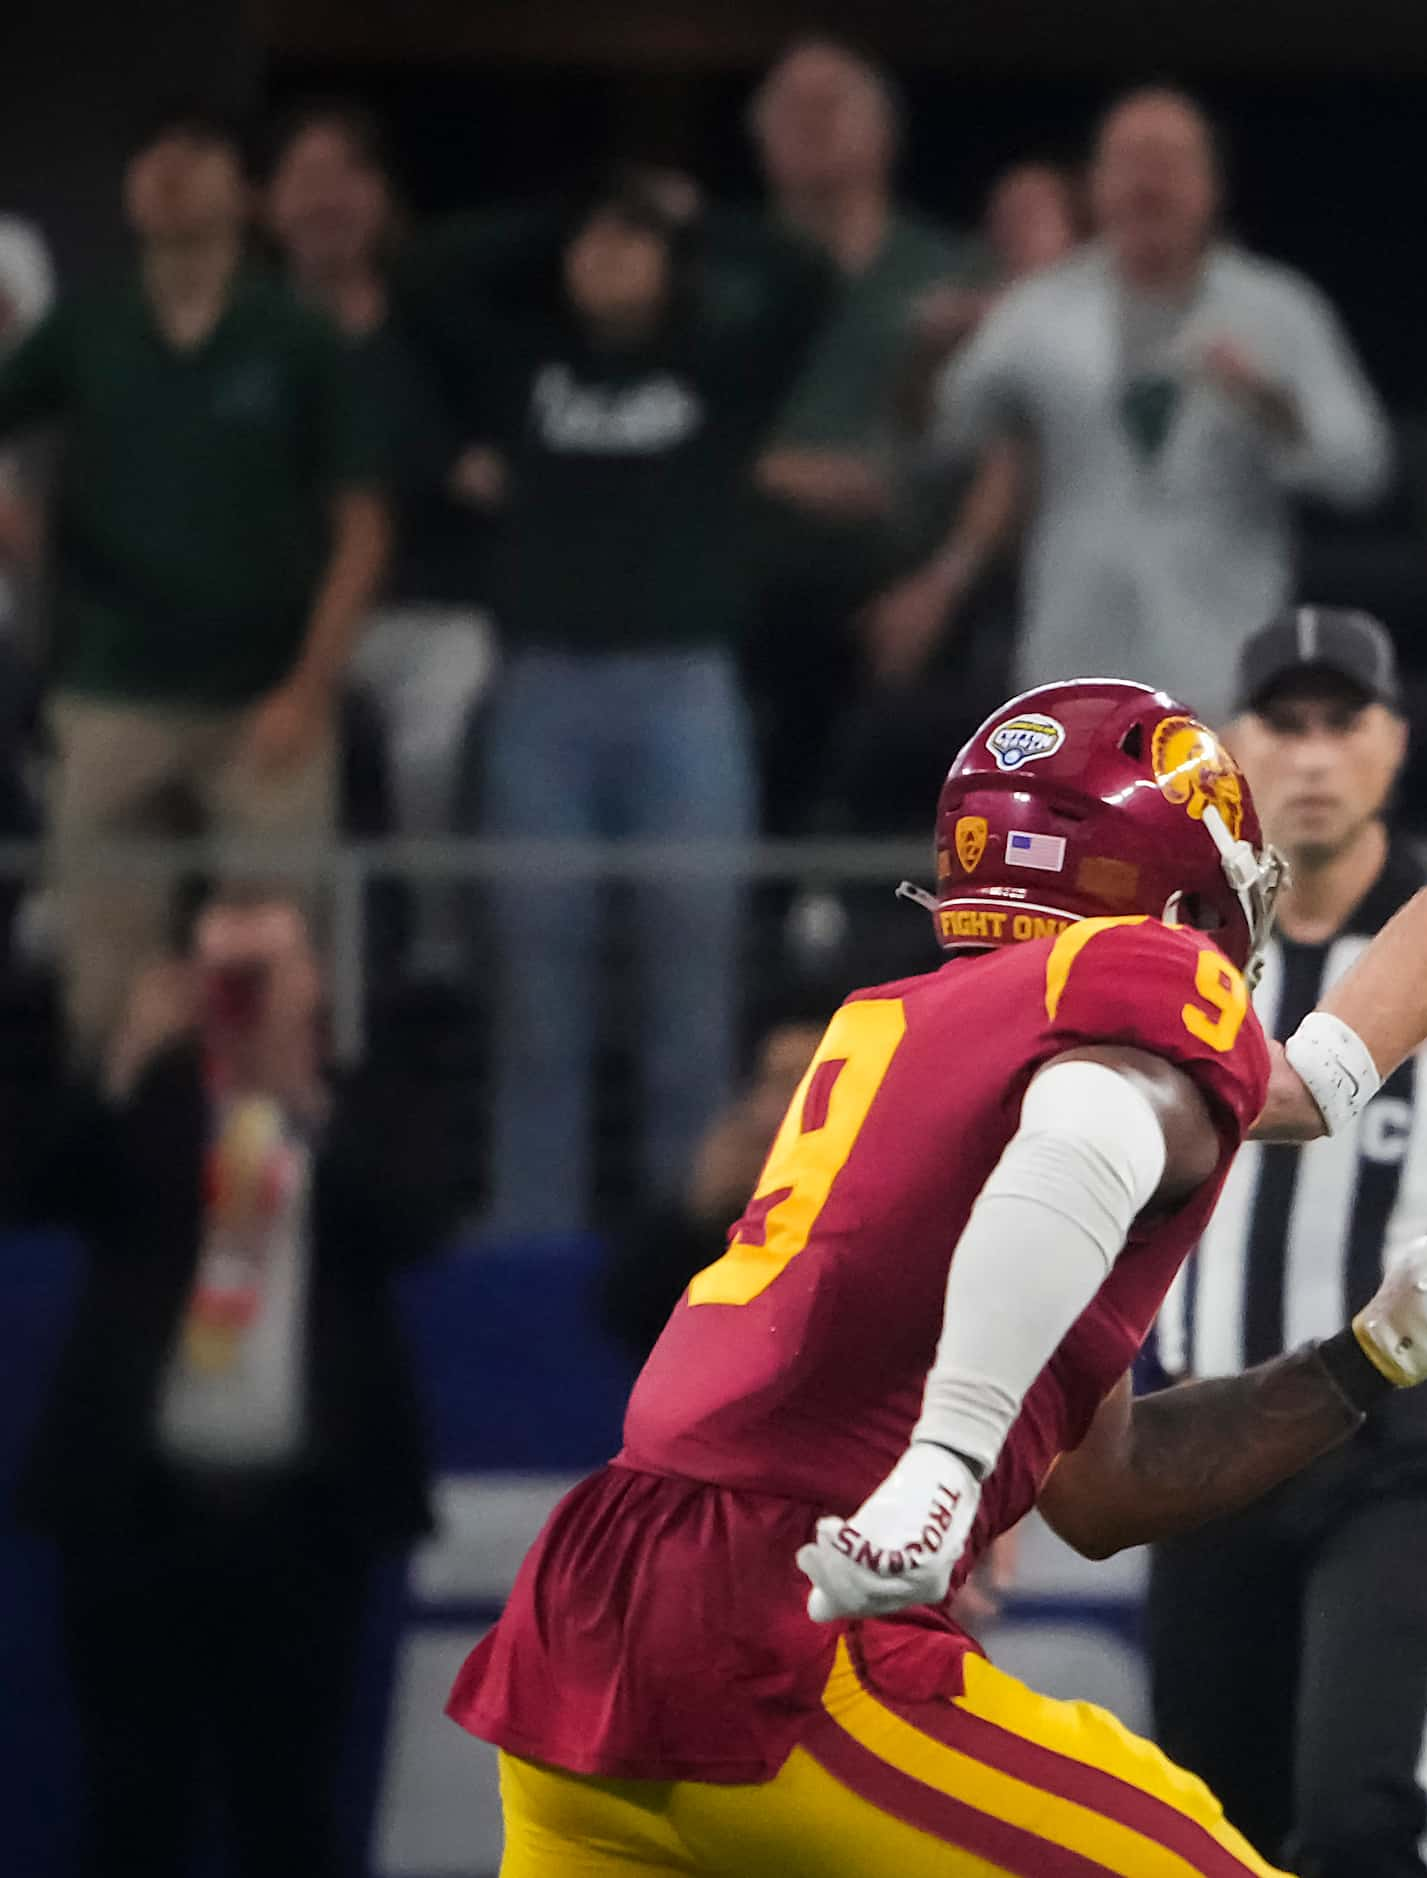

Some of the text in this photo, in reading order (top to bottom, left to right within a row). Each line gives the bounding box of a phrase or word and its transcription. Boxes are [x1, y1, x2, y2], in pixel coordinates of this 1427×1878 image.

[940, 911, 1008, 937] FIGHT
[1181, 950, 1248, 1053] 9
[688, 998, 907, 1307] 9
[1360, 1098, 1411, 1161] C
